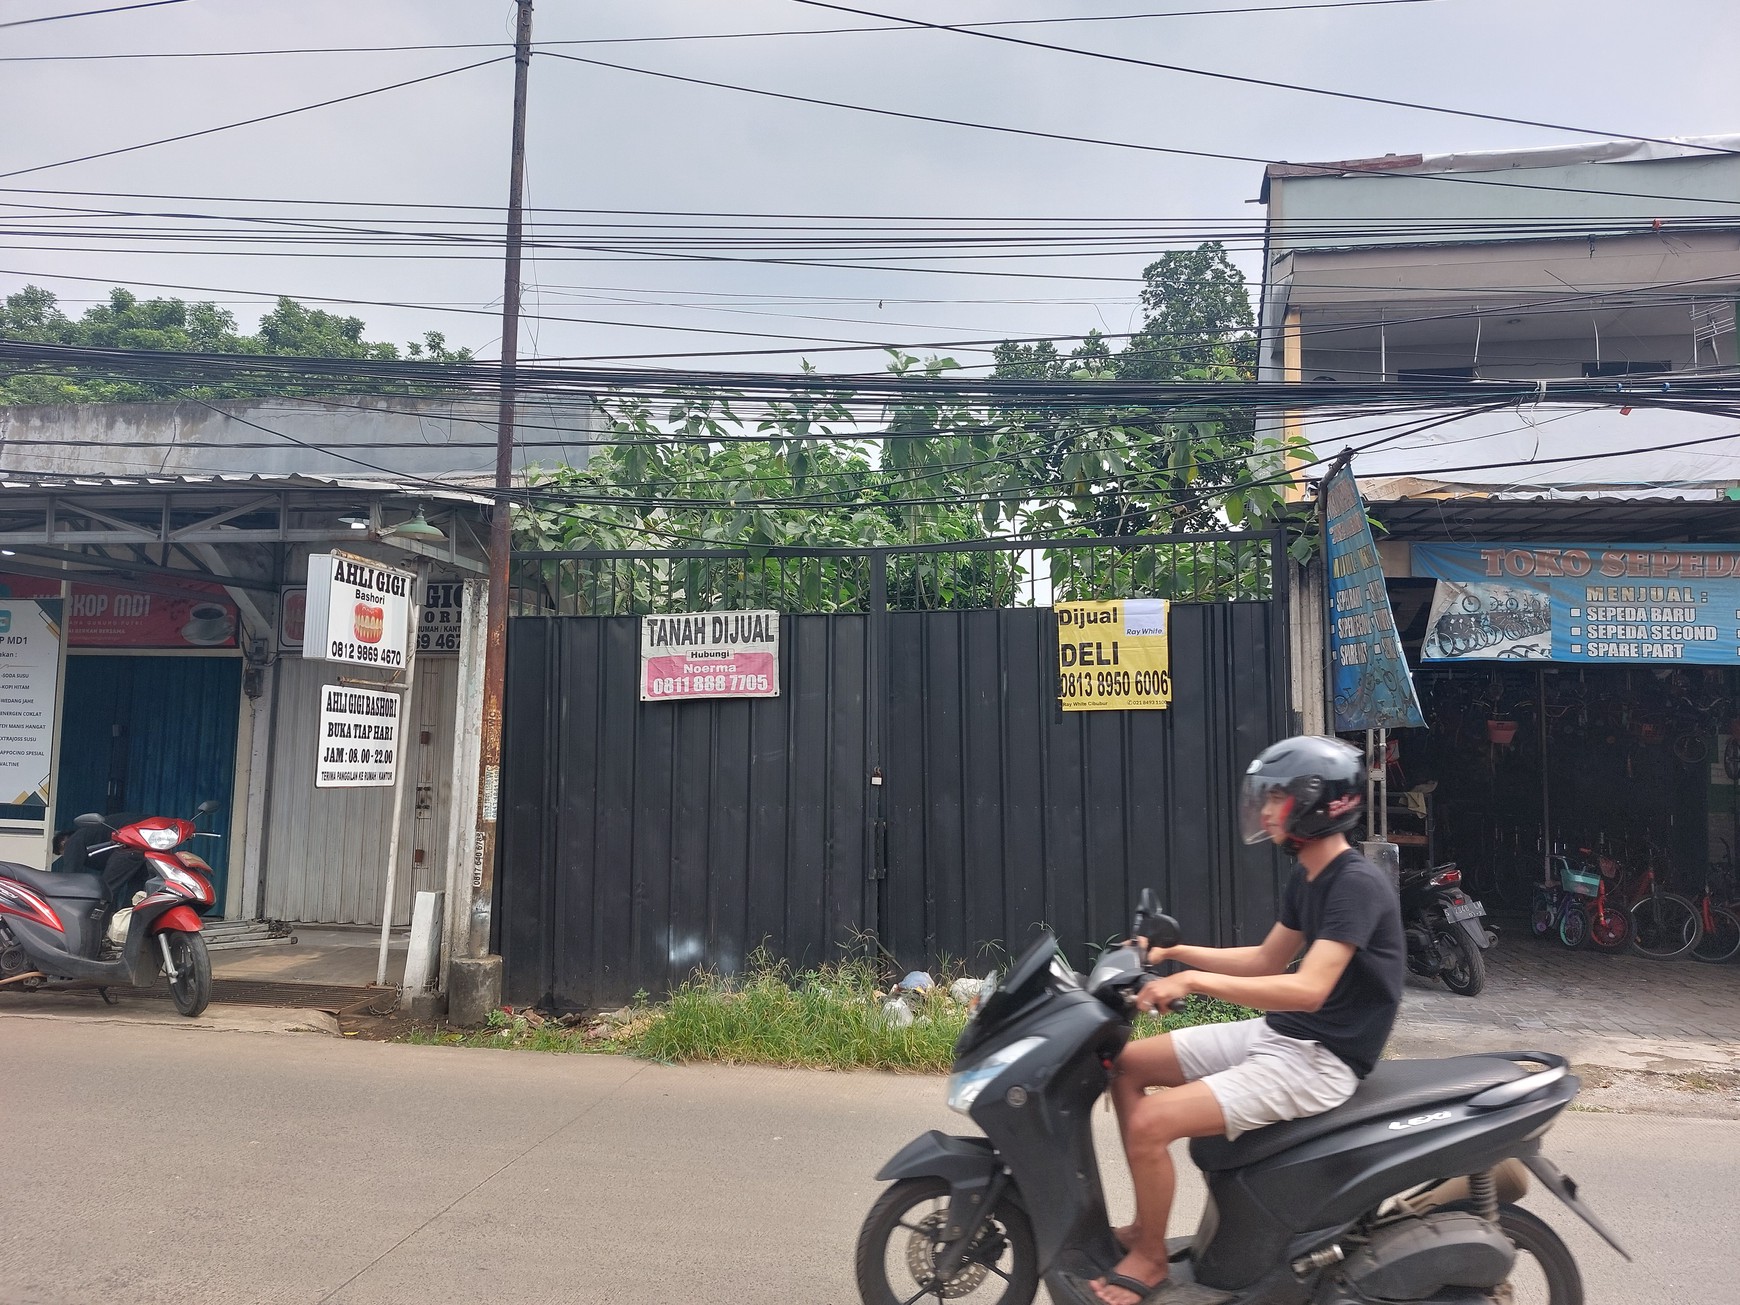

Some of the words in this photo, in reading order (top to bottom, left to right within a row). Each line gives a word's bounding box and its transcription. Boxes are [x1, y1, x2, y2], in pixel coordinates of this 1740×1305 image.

[1481, 549, 1592, 577] TOKO
[334, 560, 374, 589] AHLI
[376, 571, 406, 597] GIGI
[355, 589, 385, 604] Bashori
[1586, 587, 1695, 603] MENJUAL
[1059, 607, 1118, 629] Dijual
[1587, 606, 1648, 622] SEPEDA
[1650, 606, 1696, 623] BARU
[647, 617, 706, 647] TANAH
[712, 614, 775, 644] DIJUAL
[1126, 628, 1141, 636] Ray
[1141, 627, 1162, 635] White
[1587, 624, 1648, 640] SEPEDA
[1650, 625, 1718, 641] SECOND
[7, 636, 28, 645] MD1
[331, 640, 354, 659] 0812
[357, 644, 378, 662] 9869
[380, 648, 401, 666] 4670
[690, 650, 730, 660] Hubungi
[1060, 641, 1119, 667] DELI
[1588, 642, 1639, 657] SPARE
[1641, 642, 1684, 658] PART
[683, 663, 736, 674] Noerma
[653, 676, 690, 695] 0811
[693, 675, 726, 692] 888
[730, 674, 768, 691] 7705
[1060, 671, 1093, 698] 0813
[1097, 671, 1130, 697] 8950
[1135, 670, 1168, 696] 6006
[326, 690, 348, 714] AHLI
[348, 693, 365, 715] GIGI
[365, 695, 398, 718] BASHORI
[327, 721, 352, 738] BUKA
[353, 723, 372, 740] TIAP
[373, 725, 393, 740] HARI
[374, 749, 393, 764] 22.00
